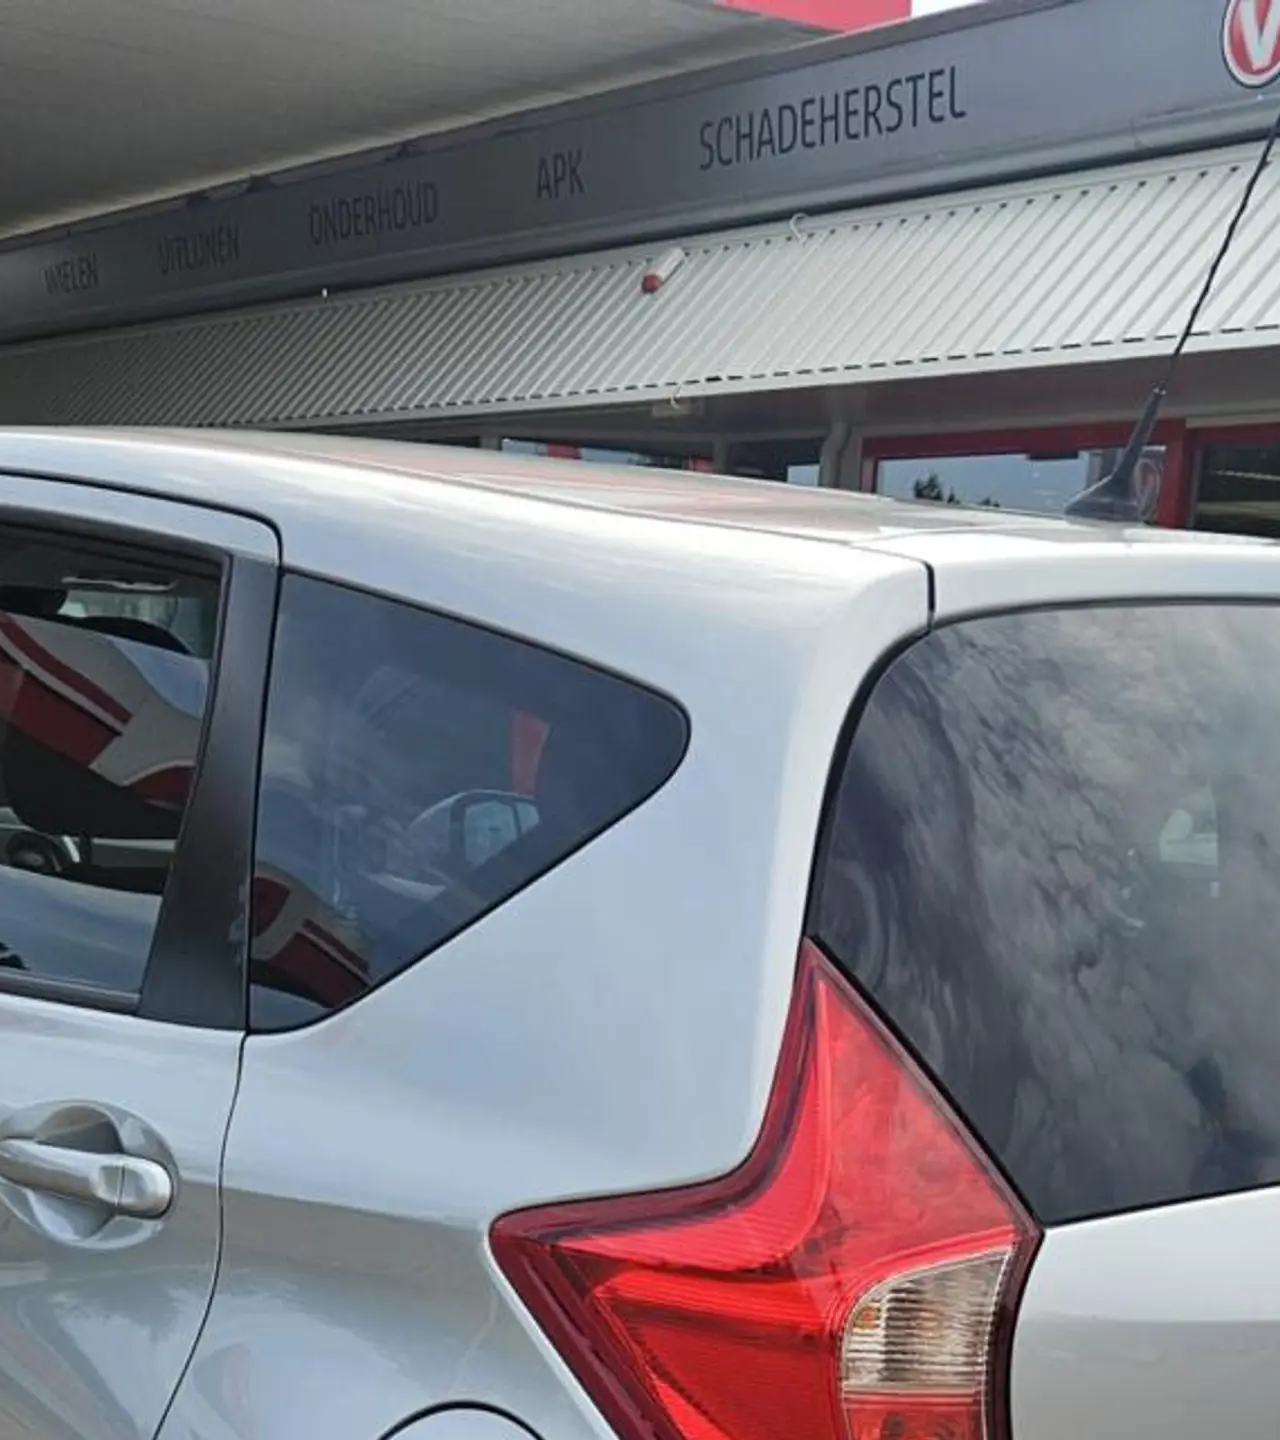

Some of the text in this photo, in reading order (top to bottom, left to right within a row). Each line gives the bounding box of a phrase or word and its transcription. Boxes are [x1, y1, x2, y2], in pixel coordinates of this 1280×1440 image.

[699, 66, 966, 170] SCHADEHERSTEL
[537, 149, 586, 199] APK
[308, 182, 440, 246] ONDERHOUD
